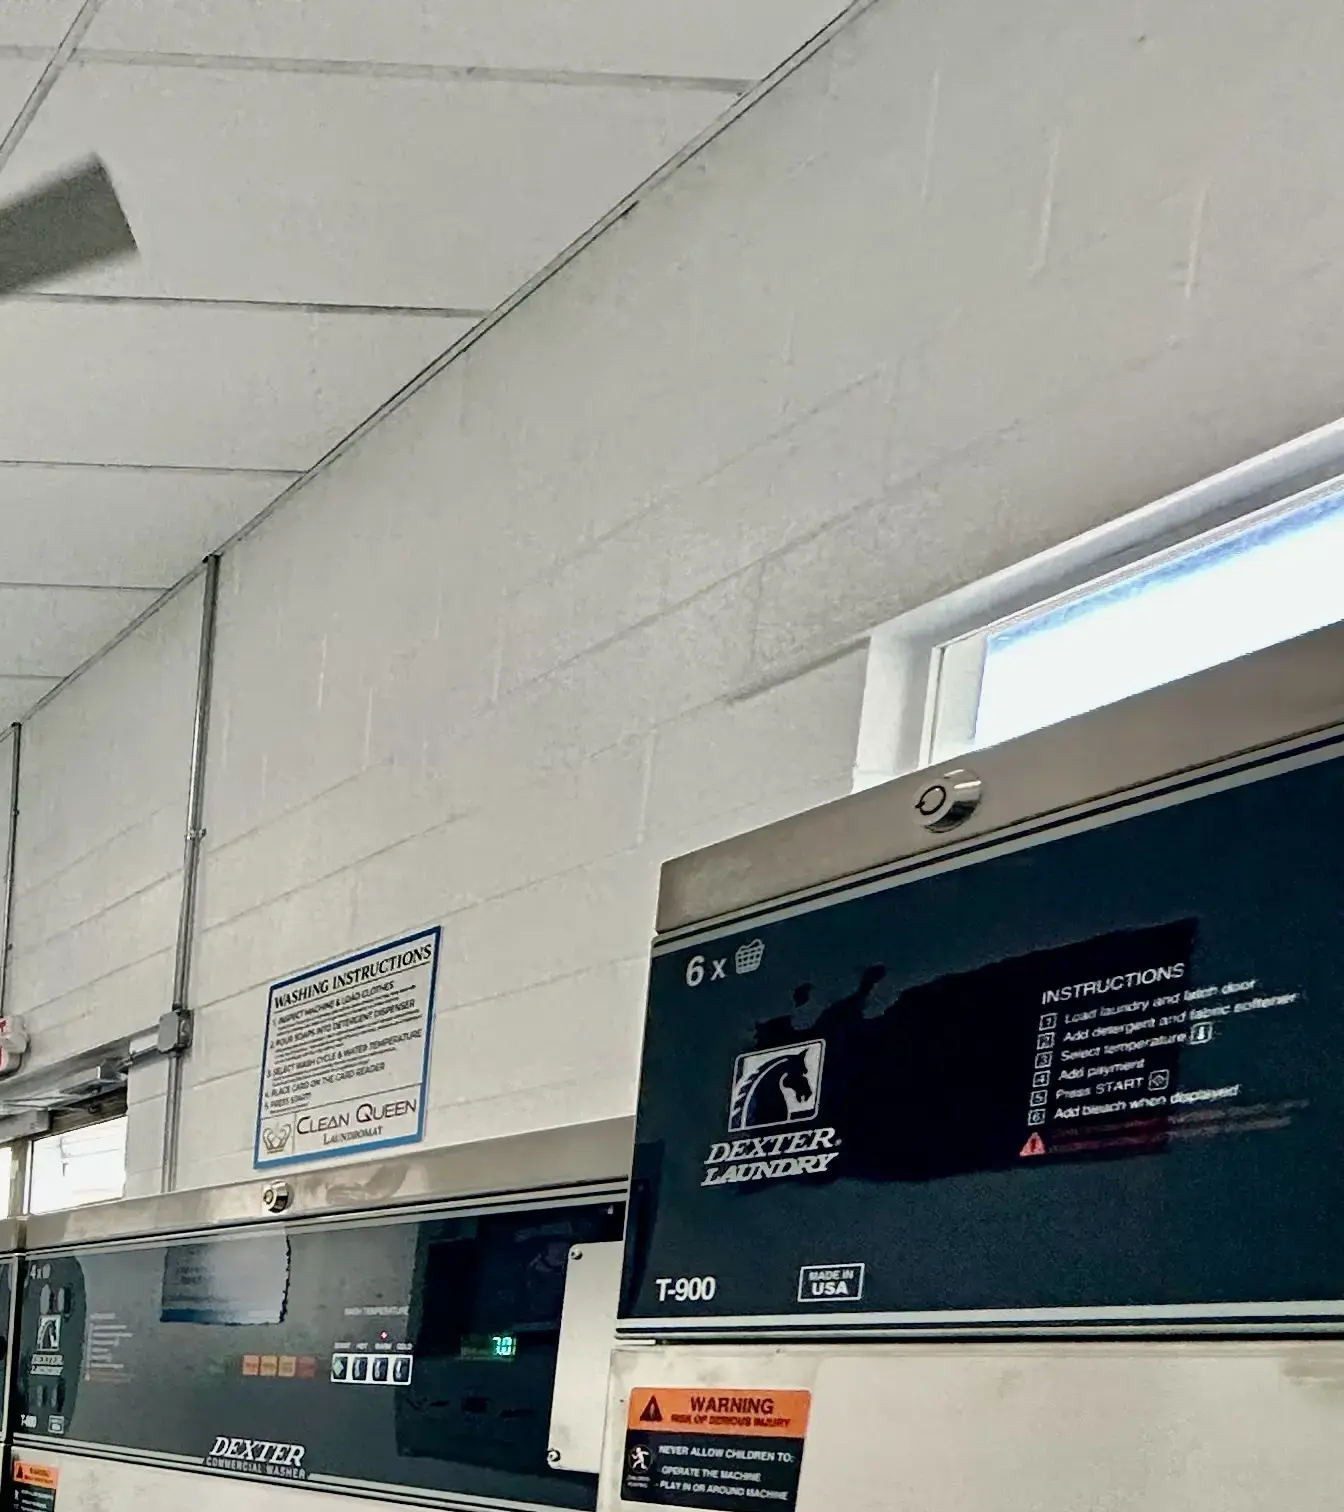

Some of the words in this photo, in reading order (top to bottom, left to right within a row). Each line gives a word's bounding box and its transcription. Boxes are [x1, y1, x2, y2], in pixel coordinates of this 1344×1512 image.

[274, 979, 330, 1010] WASHING
[332, 943, 432, 991] INSTRUCTIONS
[685, 954, 706, 987] 6
[710, 957, 728, 982] x
[1041, 962, 1186, 1005] INSTRUCTIONS
[1064, 1008, 1097, 1025] Load
[1099, 999, 1150, 1018] laundry
[1152, 992, 1182, 1008] and
[1221, 979, 1257, 995] door
[1063, 1029, 1089, 1042] Add
[1091, 1017, 1156, 1035] detergent
[1158, 1010, 1187, 1027] and
[1189, 1005, 1231, 1021] fabric
[1233, 992, 1301, 1014] softener
[1060, 1046, 1101, 1062] Select
[1103, 1032, 1188, 1055] temperature
[1057, 1067, 1085, 1081] Add
[1087, 1058, 1146, 1079] payment
[1055, 1087, 1092, 1100] Press
[1095, 1077, 1145, 1095] START
[1053, 1105, 1080, 1120] Add
[1081, 1100, 1127, 1116] bleach
[1129, 1095, 1167, 1109] when
[1170, 1084, 1241, 1105] displayed
[296, 1111, 350, 1135] CLEAN
[355, 1098, 417, 1123] QUEEN
[322, 1124, 384, 1146] LAUNDROMAT
[704, 1127, 837, 1166] DEXTER
[701, 1152, 840, 1187] LAUNDRY
[808, 1270, 840, 1282] MADE
[841, 1268, 854, 1280] IN
[656, 1276, 716, 1302] T-900
[812, 1281, 849, 1297] USA
[690, 1396, 775, 1415] WARNING
[671, 1414, 691, 1425] RISK
[693, 1415, 707, 1425] OF
[709, 1416, 752, 1427] SERIOUS
[753, 1418, 792, 1428] INJURY
[209, 1436, 305, 1468] DEXTER
[658, 1445, 689, 1456] NEVER
[690, 1446, 725, 1458] ALLOW
[725, 1448, 775, 1462] CHILDREN
[206, 1456, 262, 1474] COMMERCIAL
[265, 1464, 306, 1480] WASHER
[661, 1465, 700, 1478] OPERATE
[702, 1468, 719, 1479] THE
[720, 1469, 762, 1483] MACHINE
[660, 1479, 682, 1492] PLAY
[682, 1482, 692, 1492] IN
[693, 1483, 707, 1494] OR
[706, 1484, 745, 1497] AROUND
[746, 1487, 789, 1501] MACHINE
